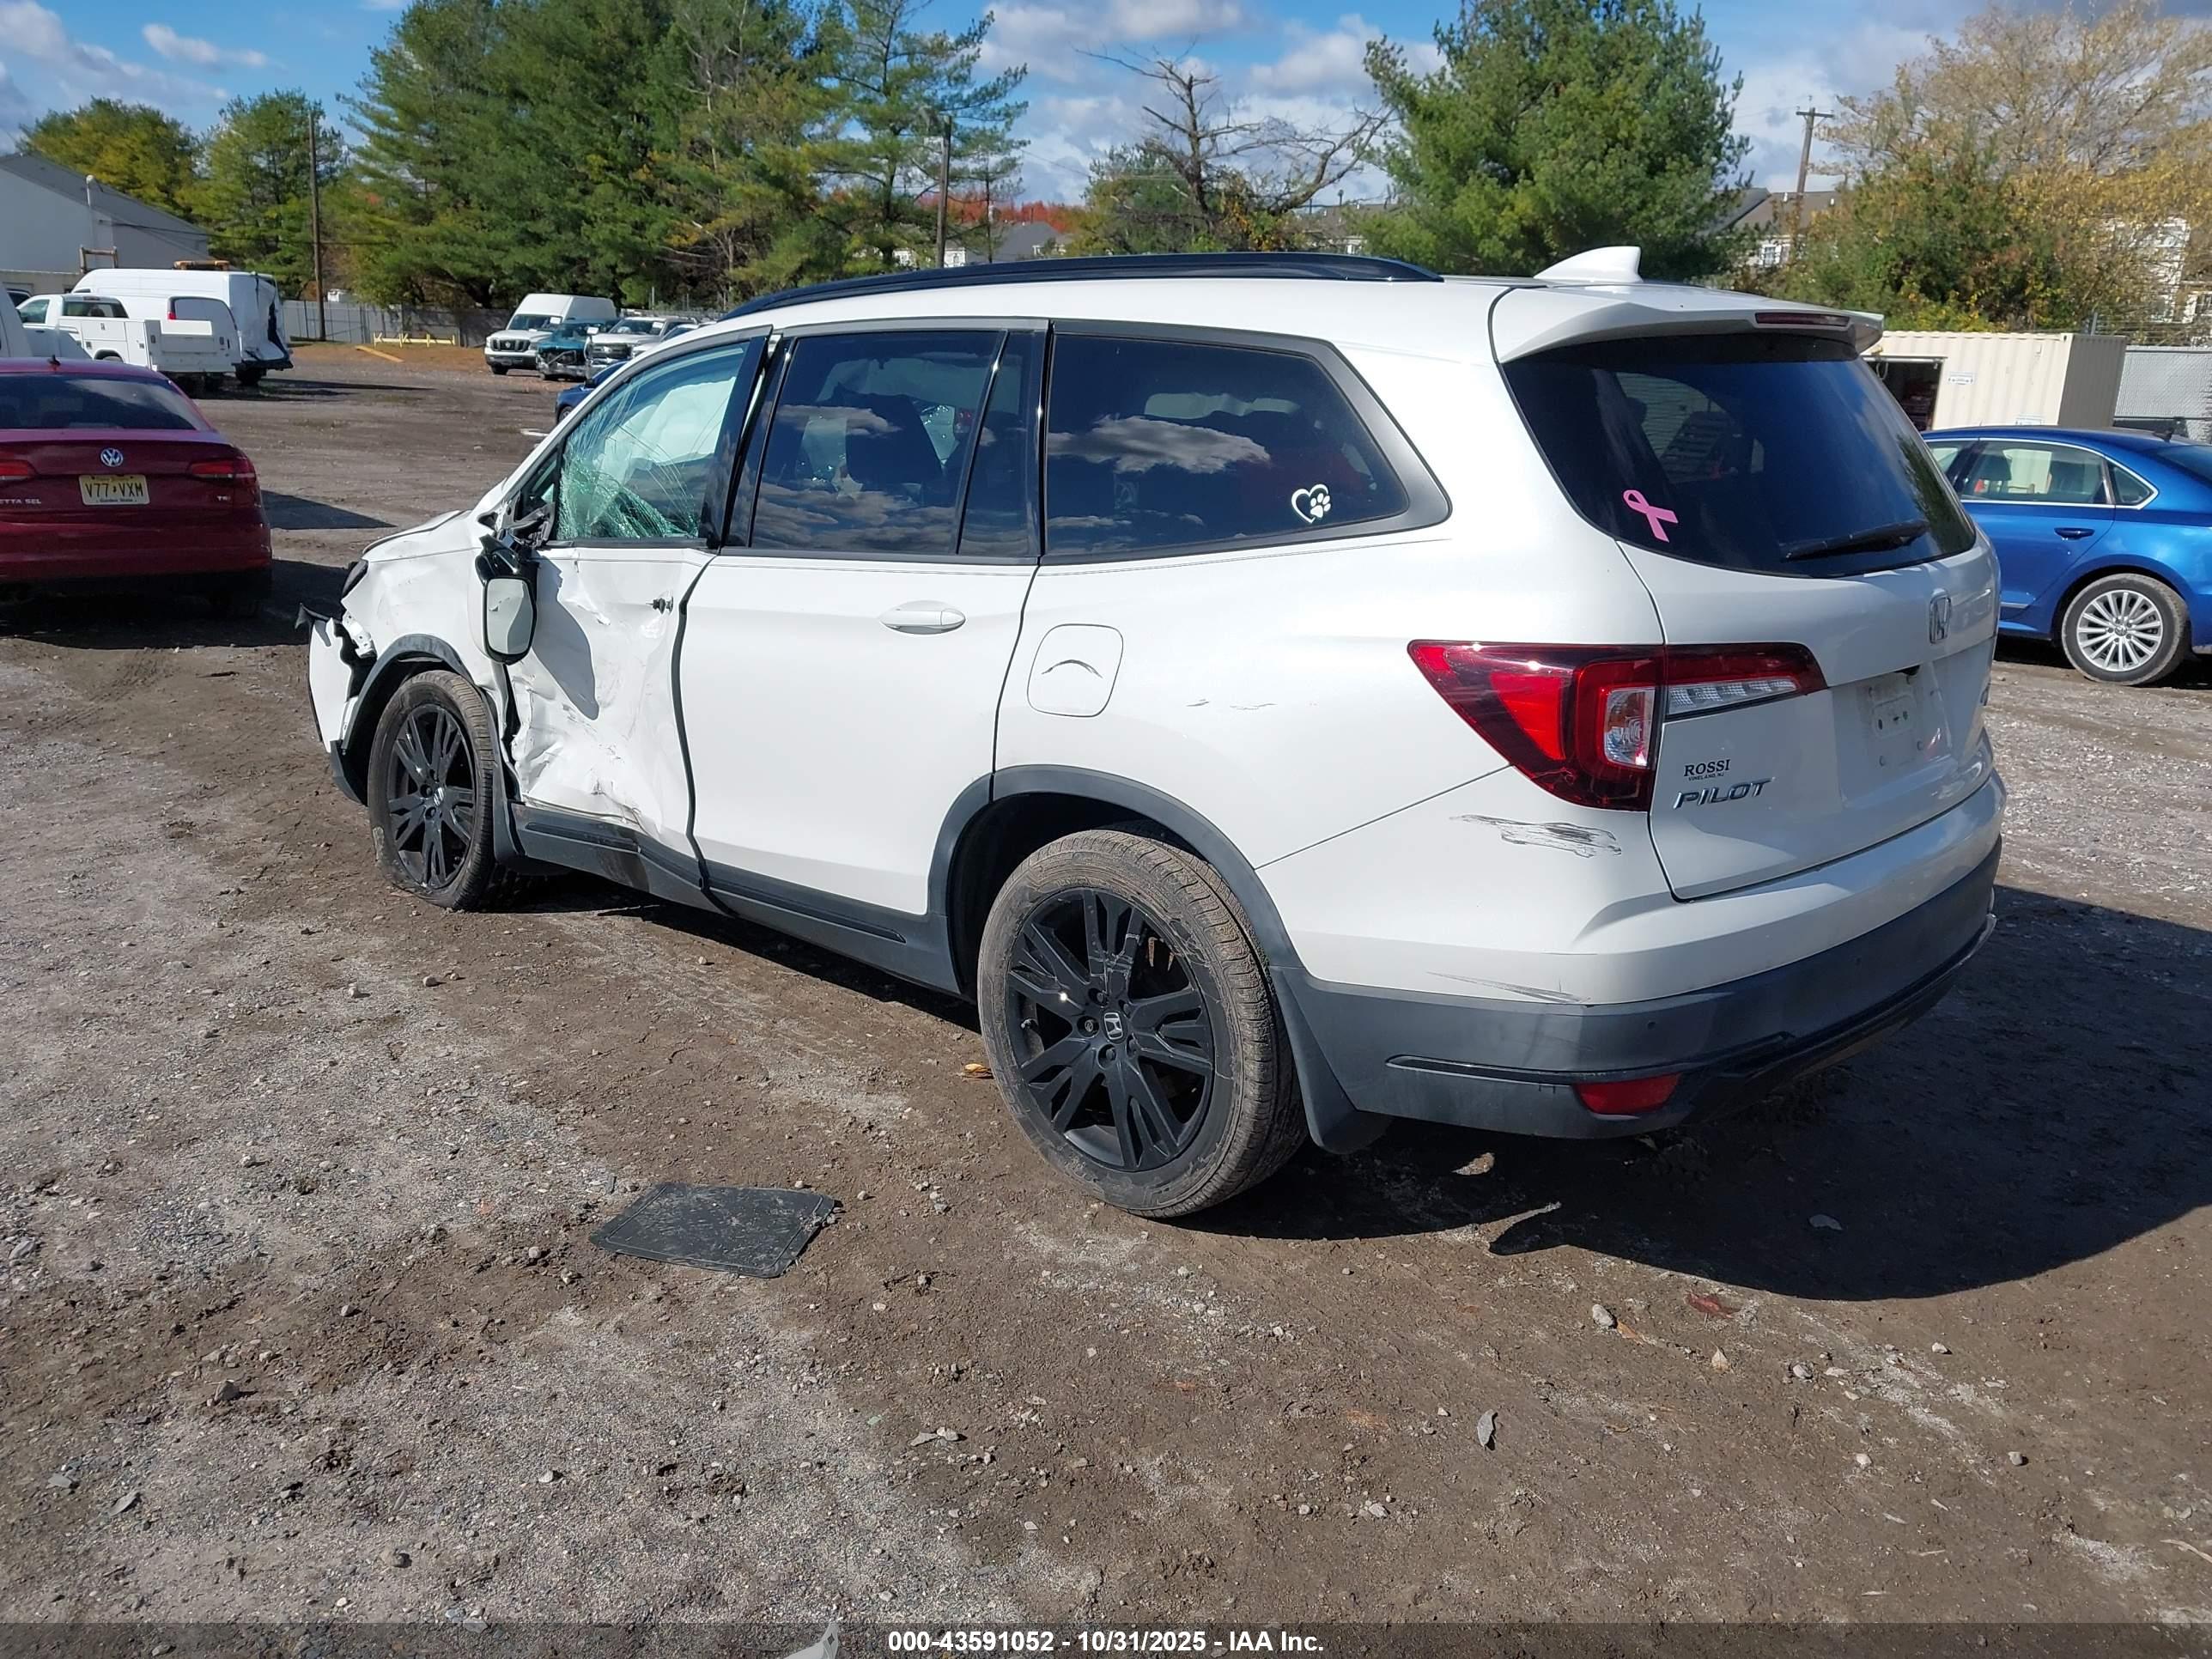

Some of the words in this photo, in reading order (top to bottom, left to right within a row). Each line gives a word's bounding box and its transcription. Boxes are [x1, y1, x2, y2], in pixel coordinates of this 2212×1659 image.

[85, 483, 109, 497] V77
[1684, 759, 1731, 777] ROSSI
[1673, 777, 1775, 810] PILOT
